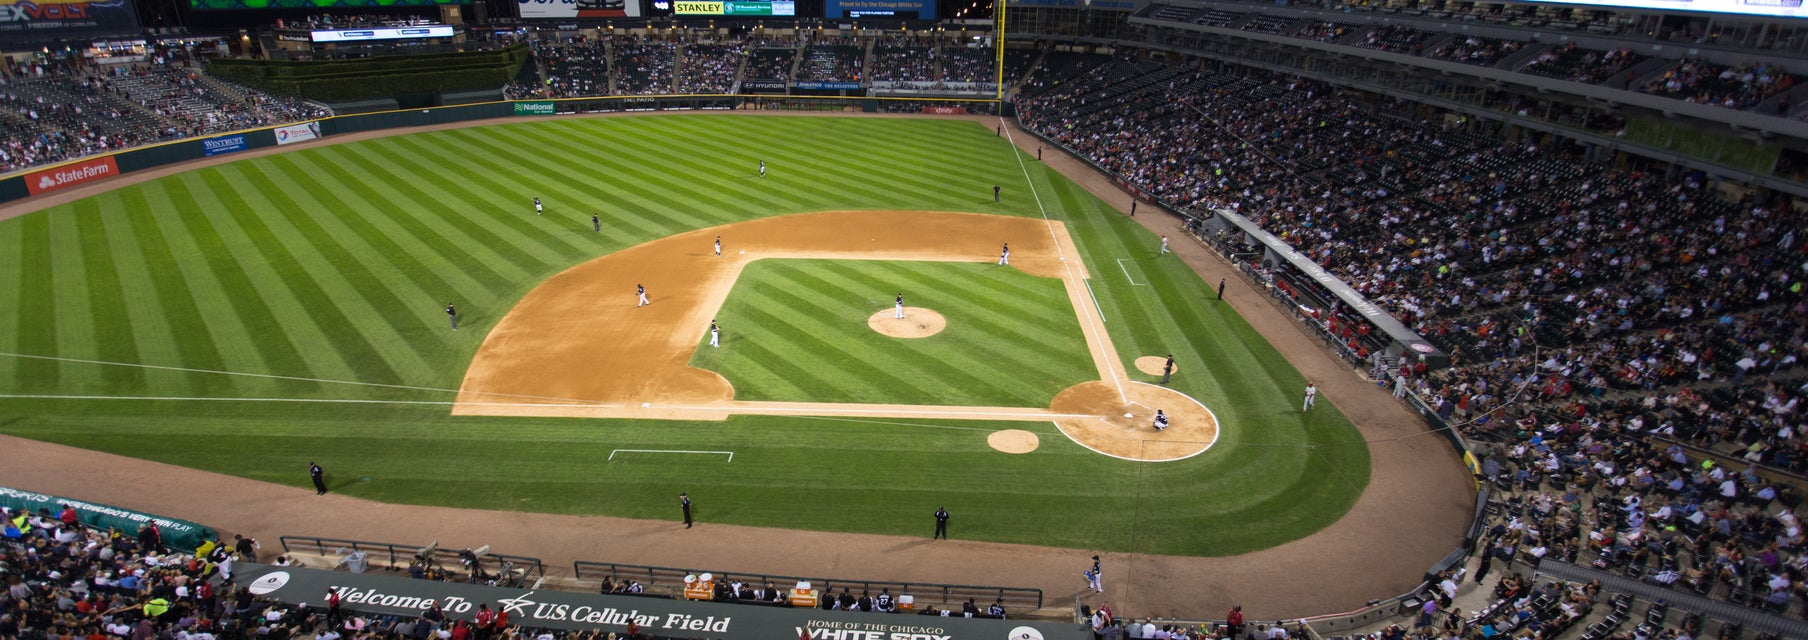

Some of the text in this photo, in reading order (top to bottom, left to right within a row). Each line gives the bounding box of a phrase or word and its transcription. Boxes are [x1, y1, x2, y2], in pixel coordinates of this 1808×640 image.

[677, 3, 721, 12] STANLEY
[27, 21, 63, 29] FREEDOM
[523, 102, 554, 111] National
[935, 107, 953, 115] xfinity
[203, 136, 245, 148] WINTRUST
[82, 503, 129, 518] CHICAGO'S
[128, 513, 152, 522] VERY
[171, 523, 193, 532] PLAY
[324, 585, 473, 613] Welcome To
[570, 605, 659, 628] Cellular
[662, 613, 731, 633] Field
[795, 626, 885, 640] WHITE
[807, 619, 944, 635] HOME OF THE CHICAGO
